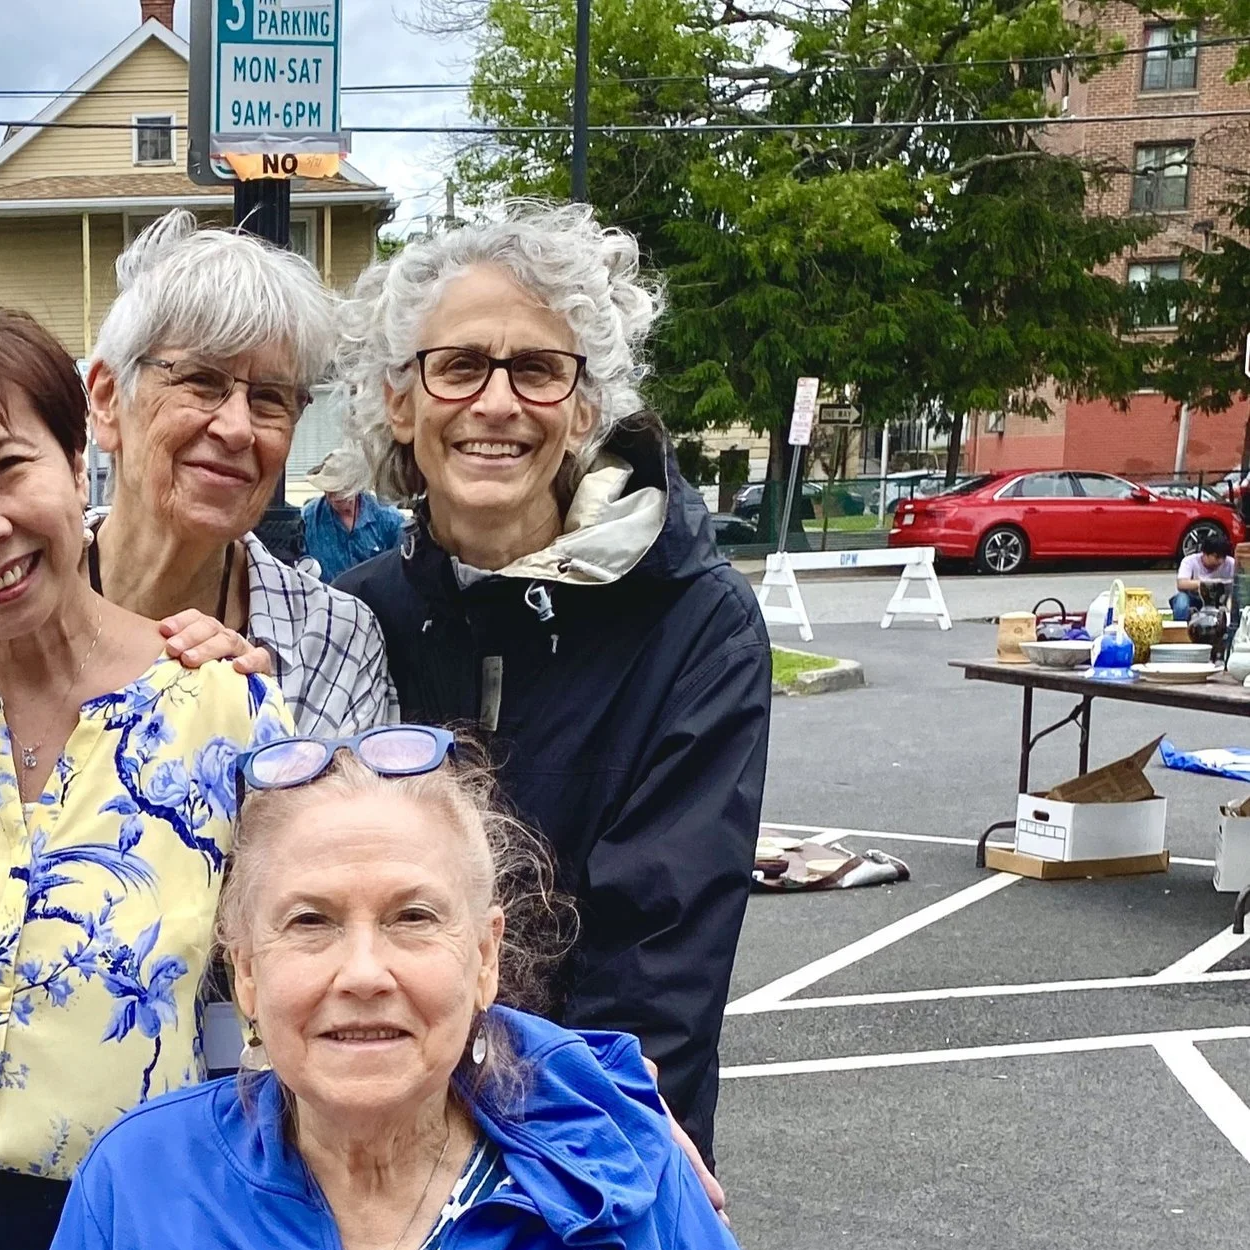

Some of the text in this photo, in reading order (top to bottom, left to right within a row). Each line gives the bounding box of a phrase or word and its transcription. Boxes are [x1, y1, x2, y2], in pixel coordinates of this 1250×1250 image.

[257, 10, 330, 37] PARKING
[233, 56, 323, 84] MON-SAT
[231, 100, 321, 128] 9AM-6PM
[262, 153, 299, 174] NO
